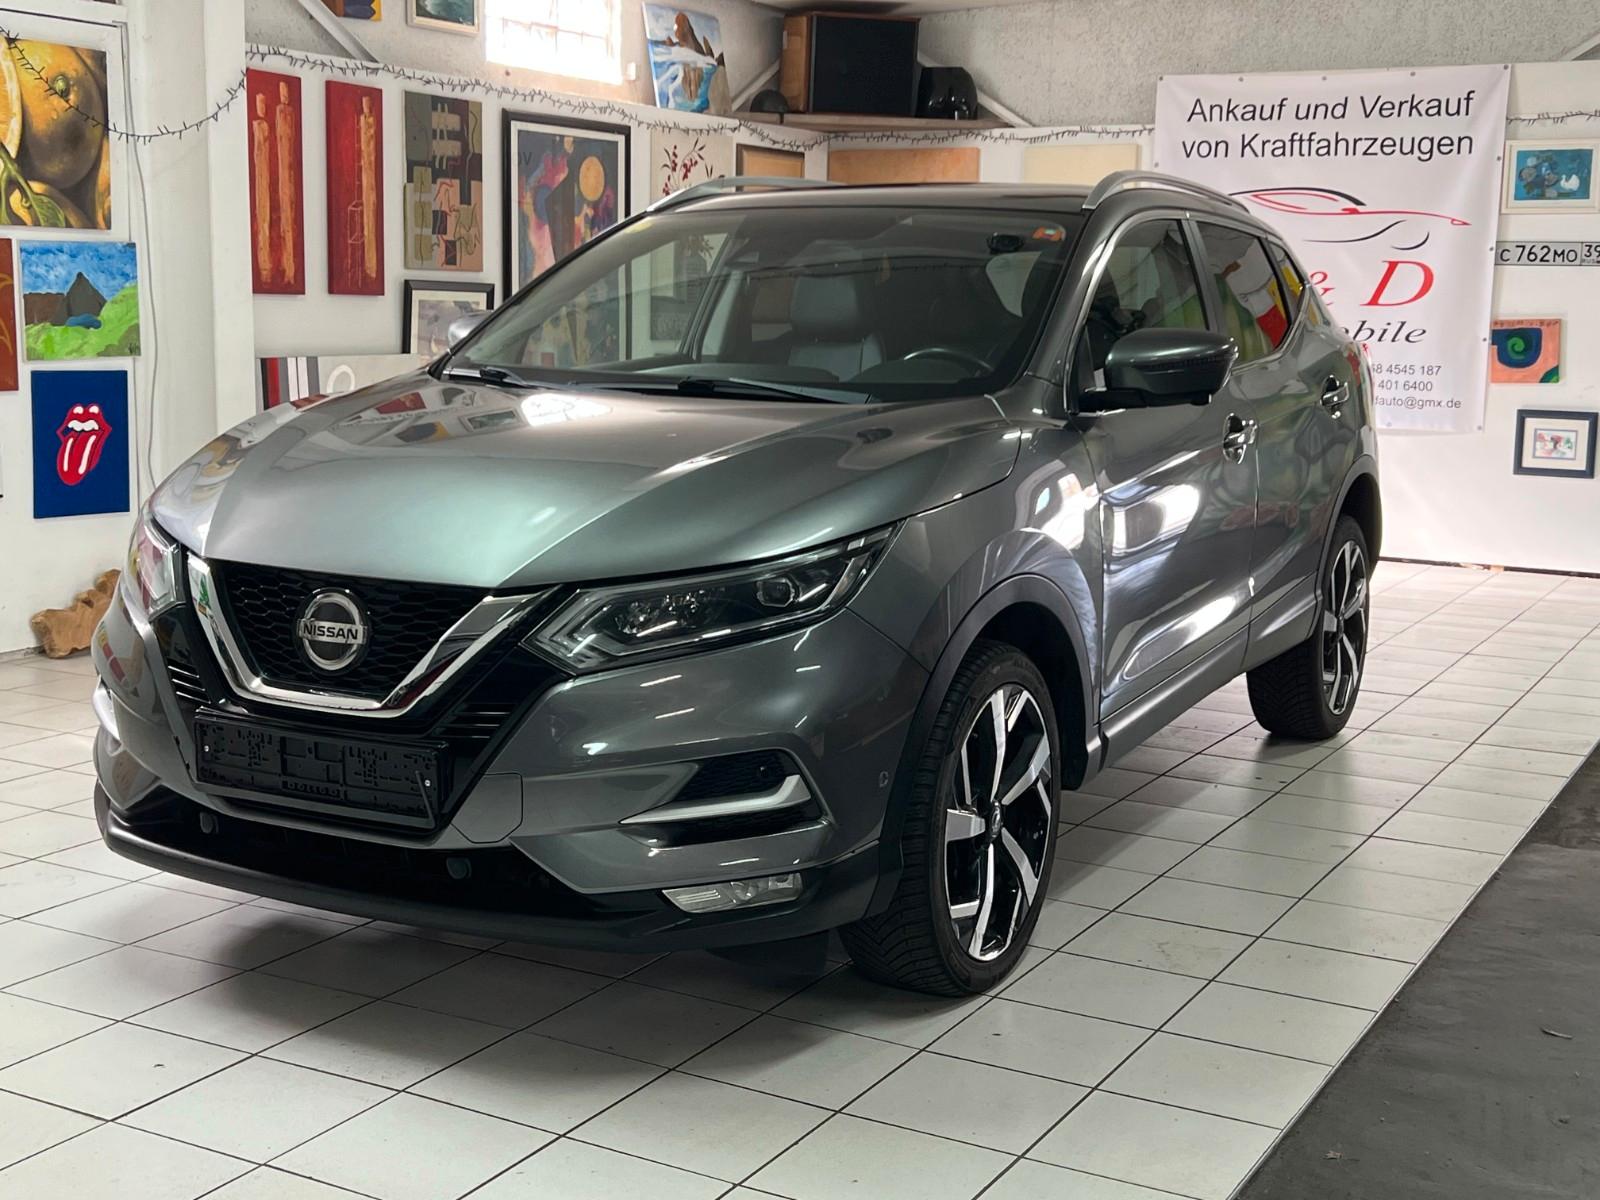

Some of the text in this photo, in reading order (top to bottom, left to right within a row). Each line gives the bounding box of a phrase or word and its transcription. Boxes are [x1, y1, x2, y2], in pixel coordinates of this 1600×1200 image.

[1187, 90, 1475, 122] Ankauf und Verkauf
[1182, 132, 1473, 162] von Kraftfahrzeugen
[1360, 260, 1434, 307] D
[1386, 364, 1415, 375] 4545
[1420, 365, 1441, 376] 187
[1378, 380, 1433, 392] 401 6400
[303, 623, 358, 640] NISSAN
